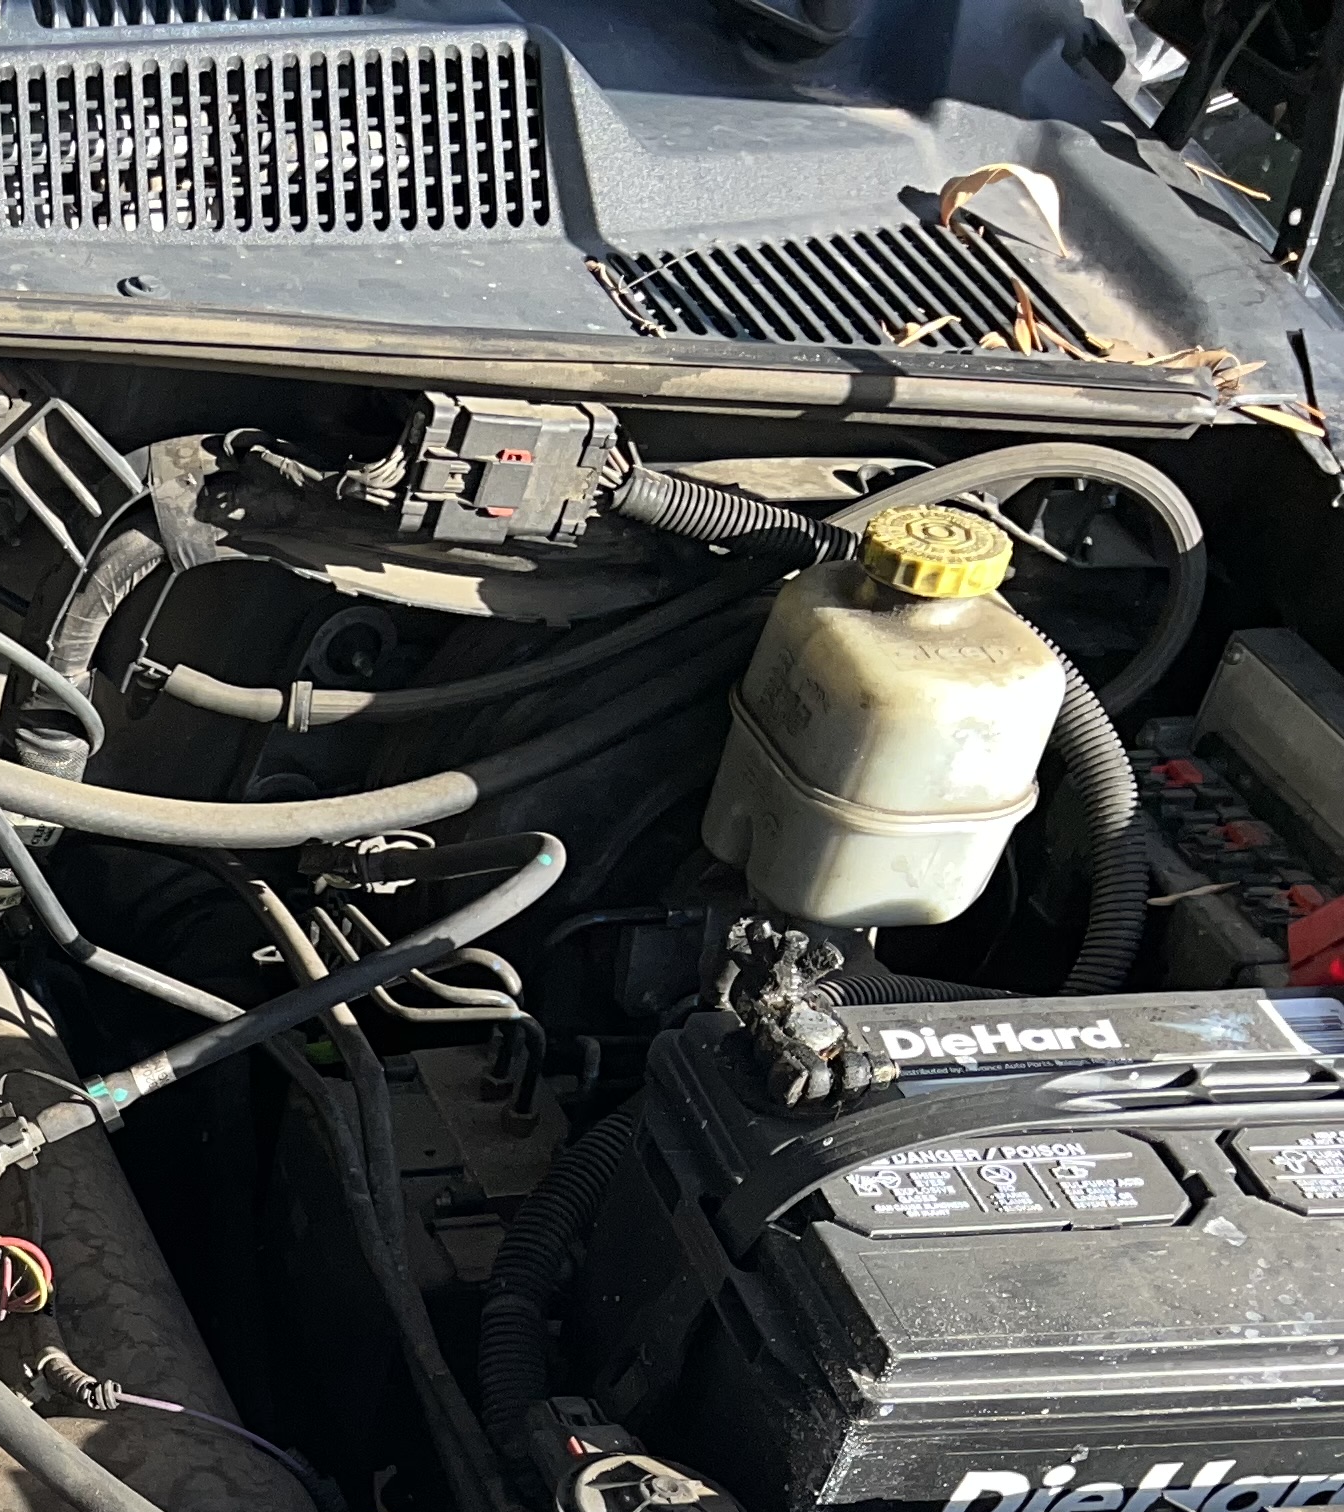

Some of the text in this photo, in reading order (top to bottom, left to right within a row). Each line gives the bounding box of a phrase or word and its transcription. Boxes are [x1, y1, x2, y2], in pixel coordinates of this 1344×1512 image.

[879, 1019, 1123, 1060] DieHard
[891, 1148, 981, 1165] DANGER
[1004, 1143, 1087, 1159] POISON
